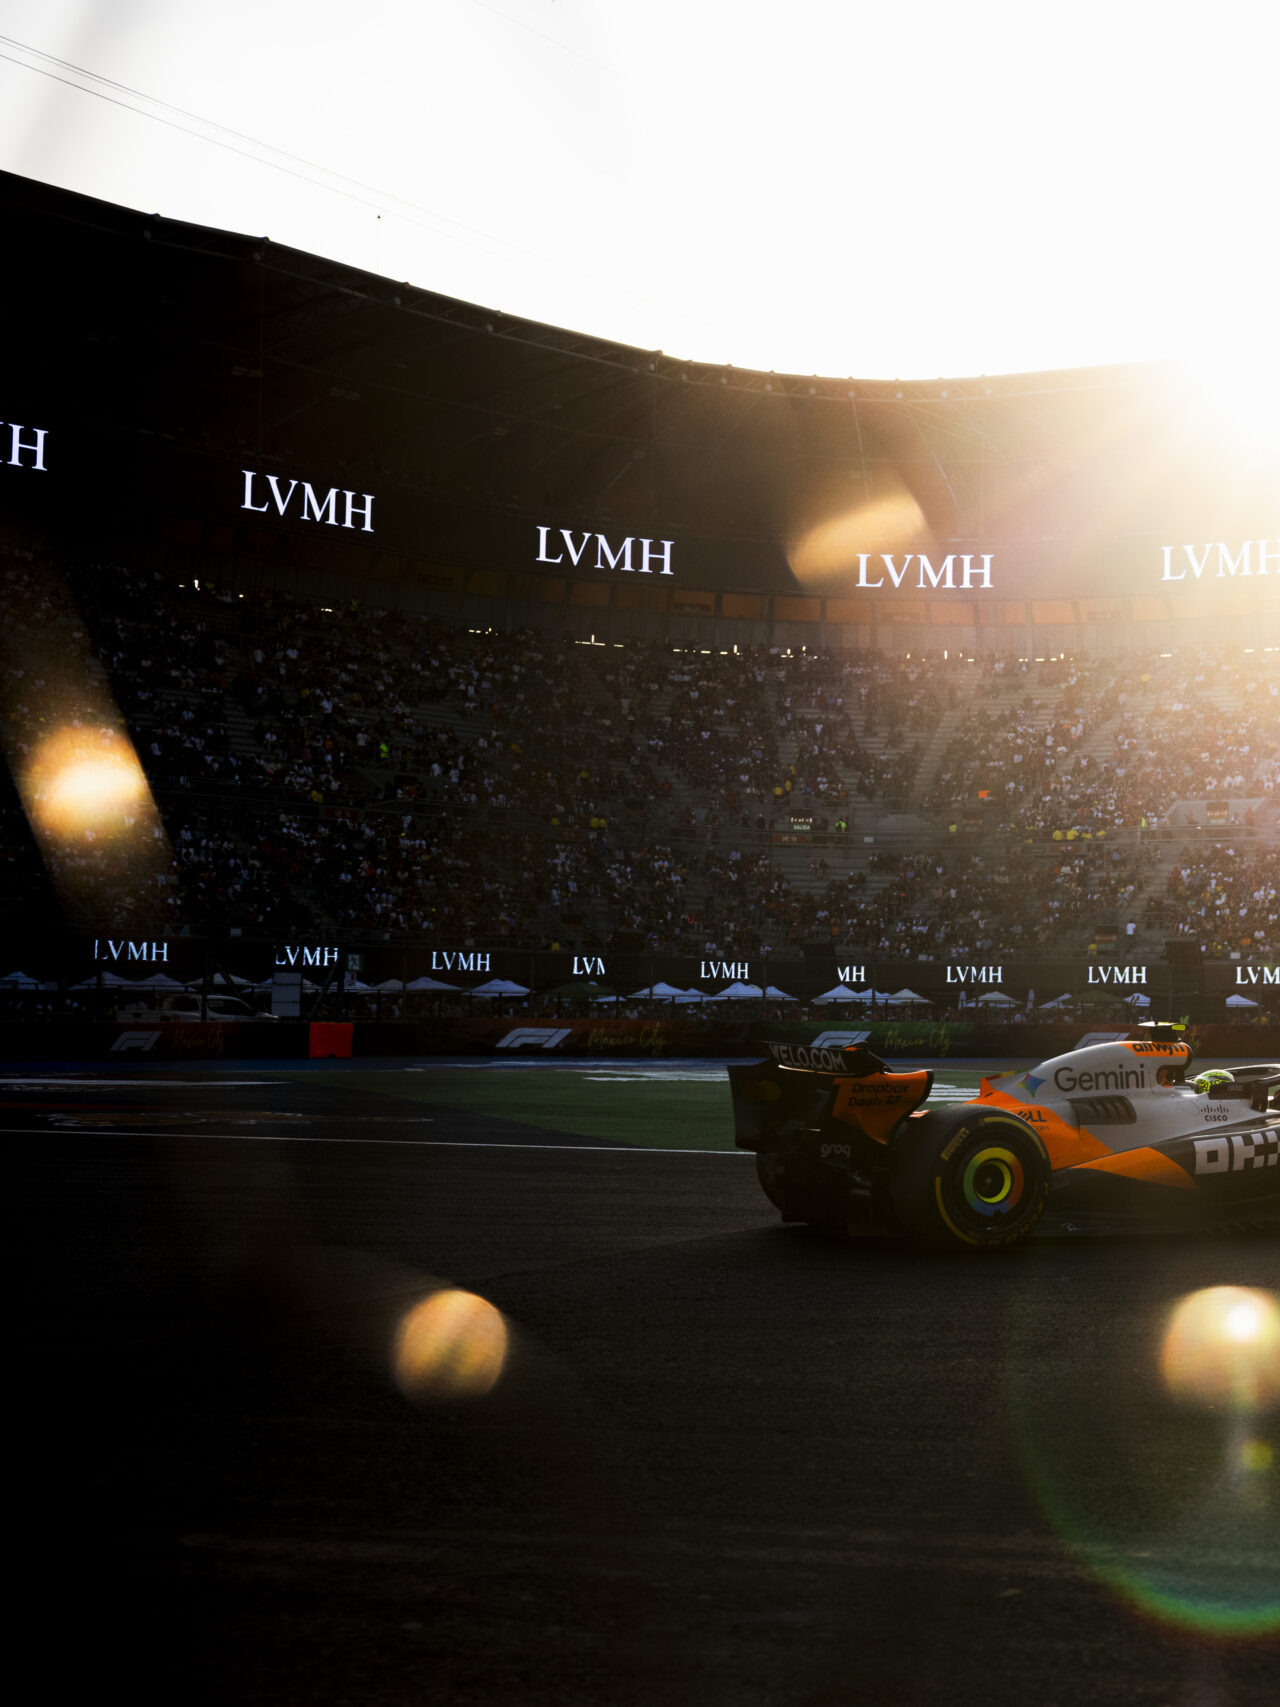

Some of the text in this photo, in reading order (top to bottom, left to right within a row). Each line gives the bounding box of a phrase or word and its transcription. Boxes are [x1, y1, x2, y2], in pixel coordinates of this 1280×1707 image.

[0, 421, 48, 471] H
[240, 469, 375, 532] LVMH
[536, 526, 675, 575] LVMH
[855, 553, 994, 588] LVMH
[93, 939, 169, 963] LVMH
[431, 951, 492, 973] LVMH
[700, 961, 750, 980] LVMH
[946, 966, 1003, 984] LVMH
[1087, 966, 1147, 984] LVMH
[109, 1030, 162, 1052] F1
[494, 1027, 573, 1048] F1
[769, 1044, 848, 1071] VELO.COM
[852, 1083, 909, 1094] Dropbox
[1054, 1063, 1145, 1092] Gemini
[847, 1096, 881, 1108] Dash
[820, 1142, 851, 1158] groq
